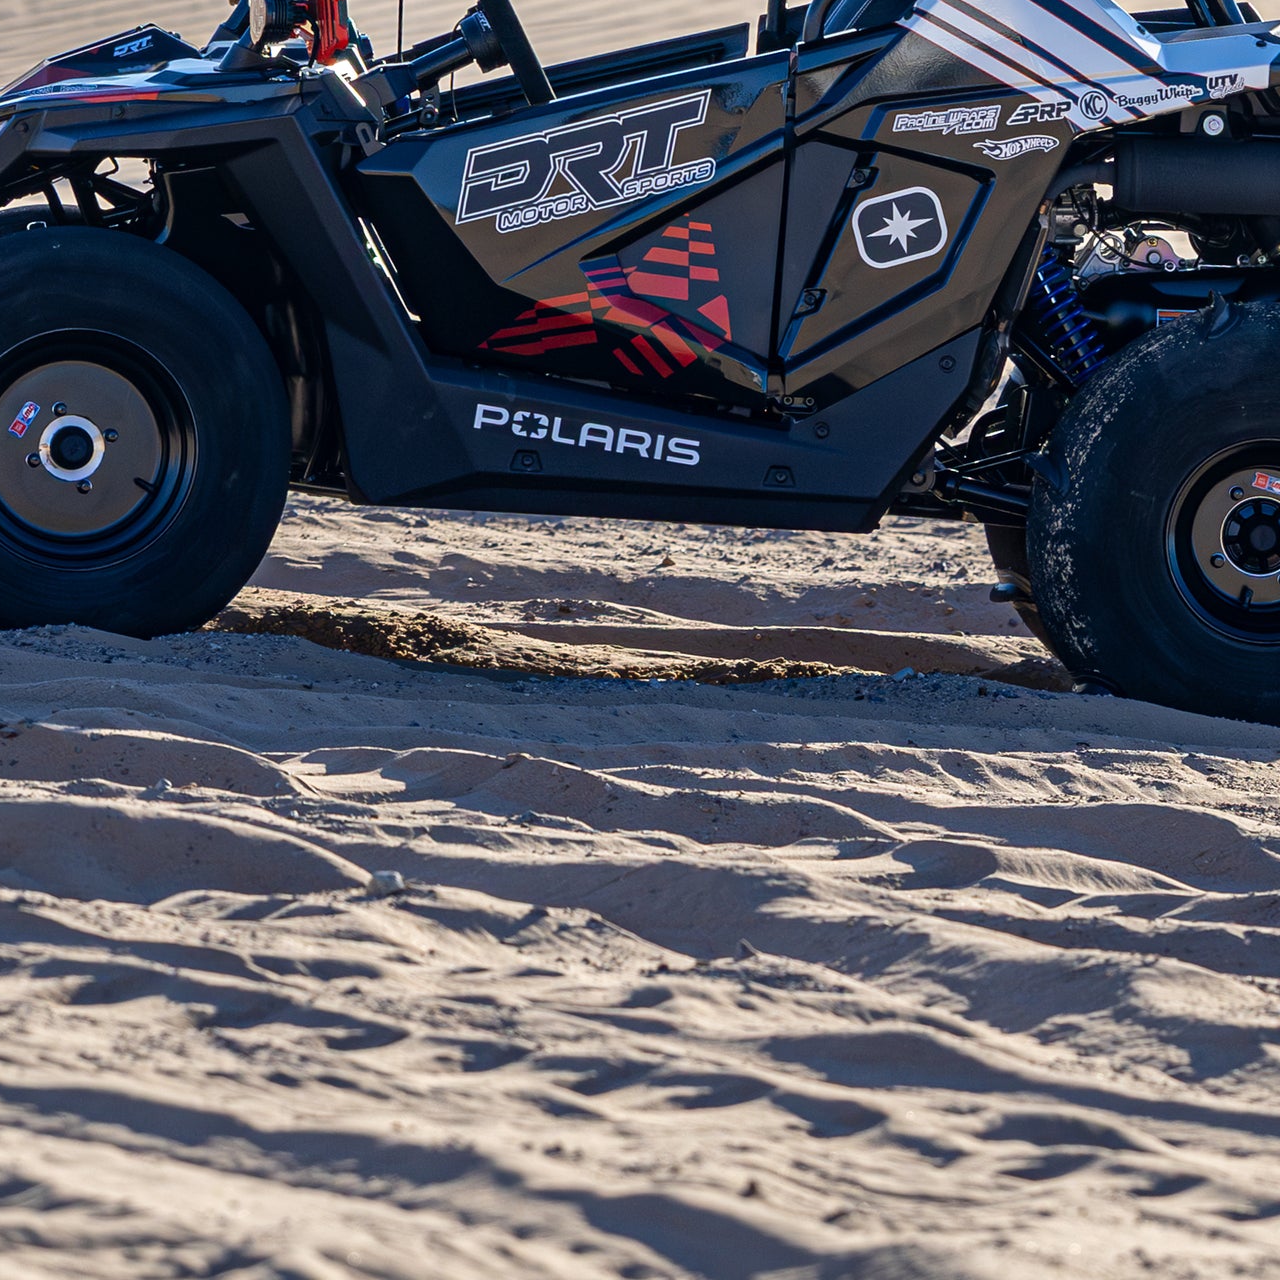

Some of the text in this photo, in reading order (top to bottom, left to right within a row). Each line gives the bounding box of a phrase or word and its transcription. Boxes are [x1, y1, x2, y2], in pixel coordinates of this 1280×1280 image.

[1209, 74, 1238, 89] UTV
[1019, 102, 1071, 123] PRP
[1084, 96, 1104, 117] KC
[455, 89, 712, 224] DRT
[499, 163, 713, 230] MOTOR SPORTS
[473, 403, 700, 466] POLARIS
